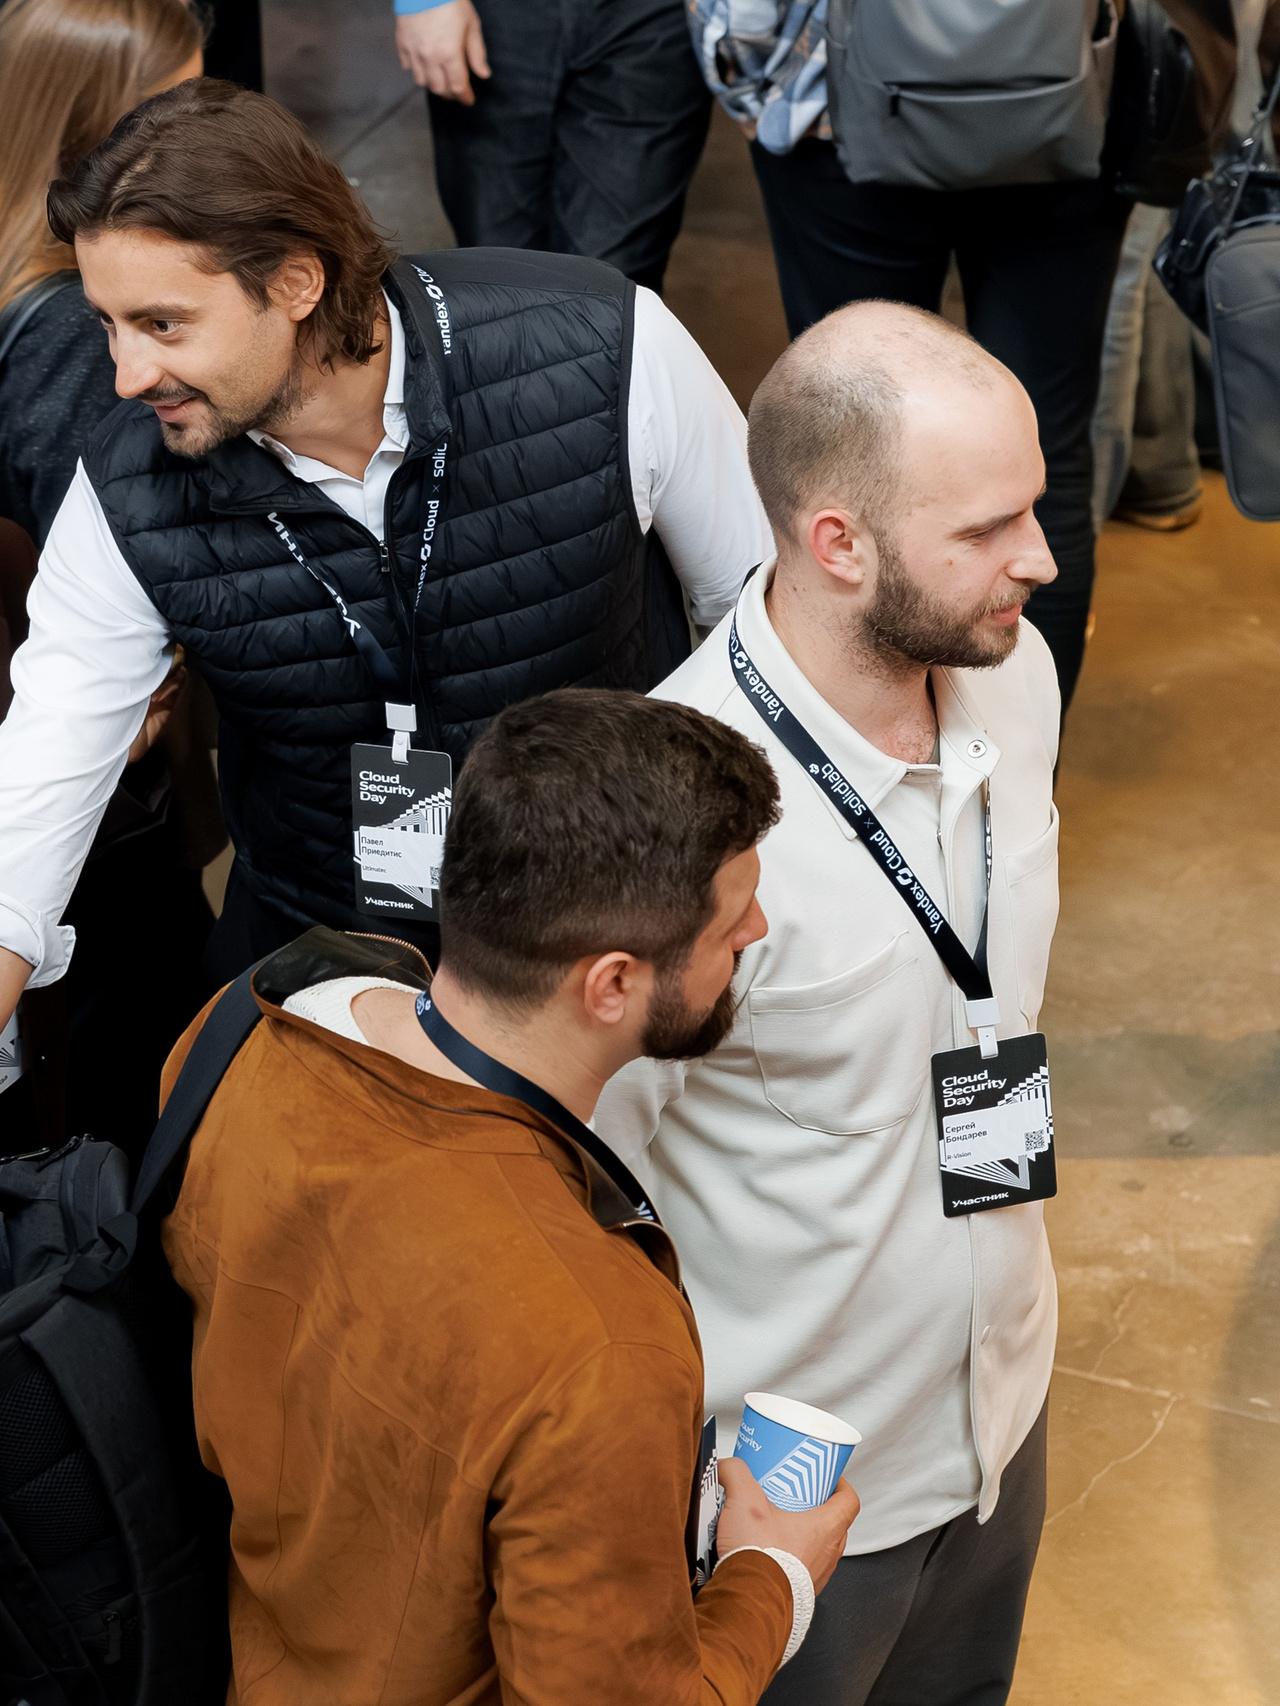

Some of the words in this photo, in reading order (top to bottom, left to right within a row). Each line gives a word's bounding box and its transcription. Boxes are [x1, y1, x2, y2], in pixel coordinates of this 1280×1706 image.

[423, 499, 440, 541] Cloud
[743, 665, 784, 722] Yandex
[359, 770, 400, 784] Cloud
[359, 781, 415, 797] Security
[821, 762, 867, 816] solidlab
[359, 791, 387, 805] Day
[361, 836, 384, 846] Павел
[869, 829, 902, 870] Cloud
[364, 896, 414, 910] Участник
[910, 881, 944, 934] Yandex
[941, 1069, 989, 1087] Cloud
[942, 1078, 1007, 1099] Security
[943, 1095, 976, 1108] Day
[945, 1121, 976, 1134] Сергей
[946, 1130, 988, 1143] Бондарев
[952, 1192, 1009, 1208] Участник
[740, 1419, 756, 1437] oud
[738, 1430, 763, 1452] curity
